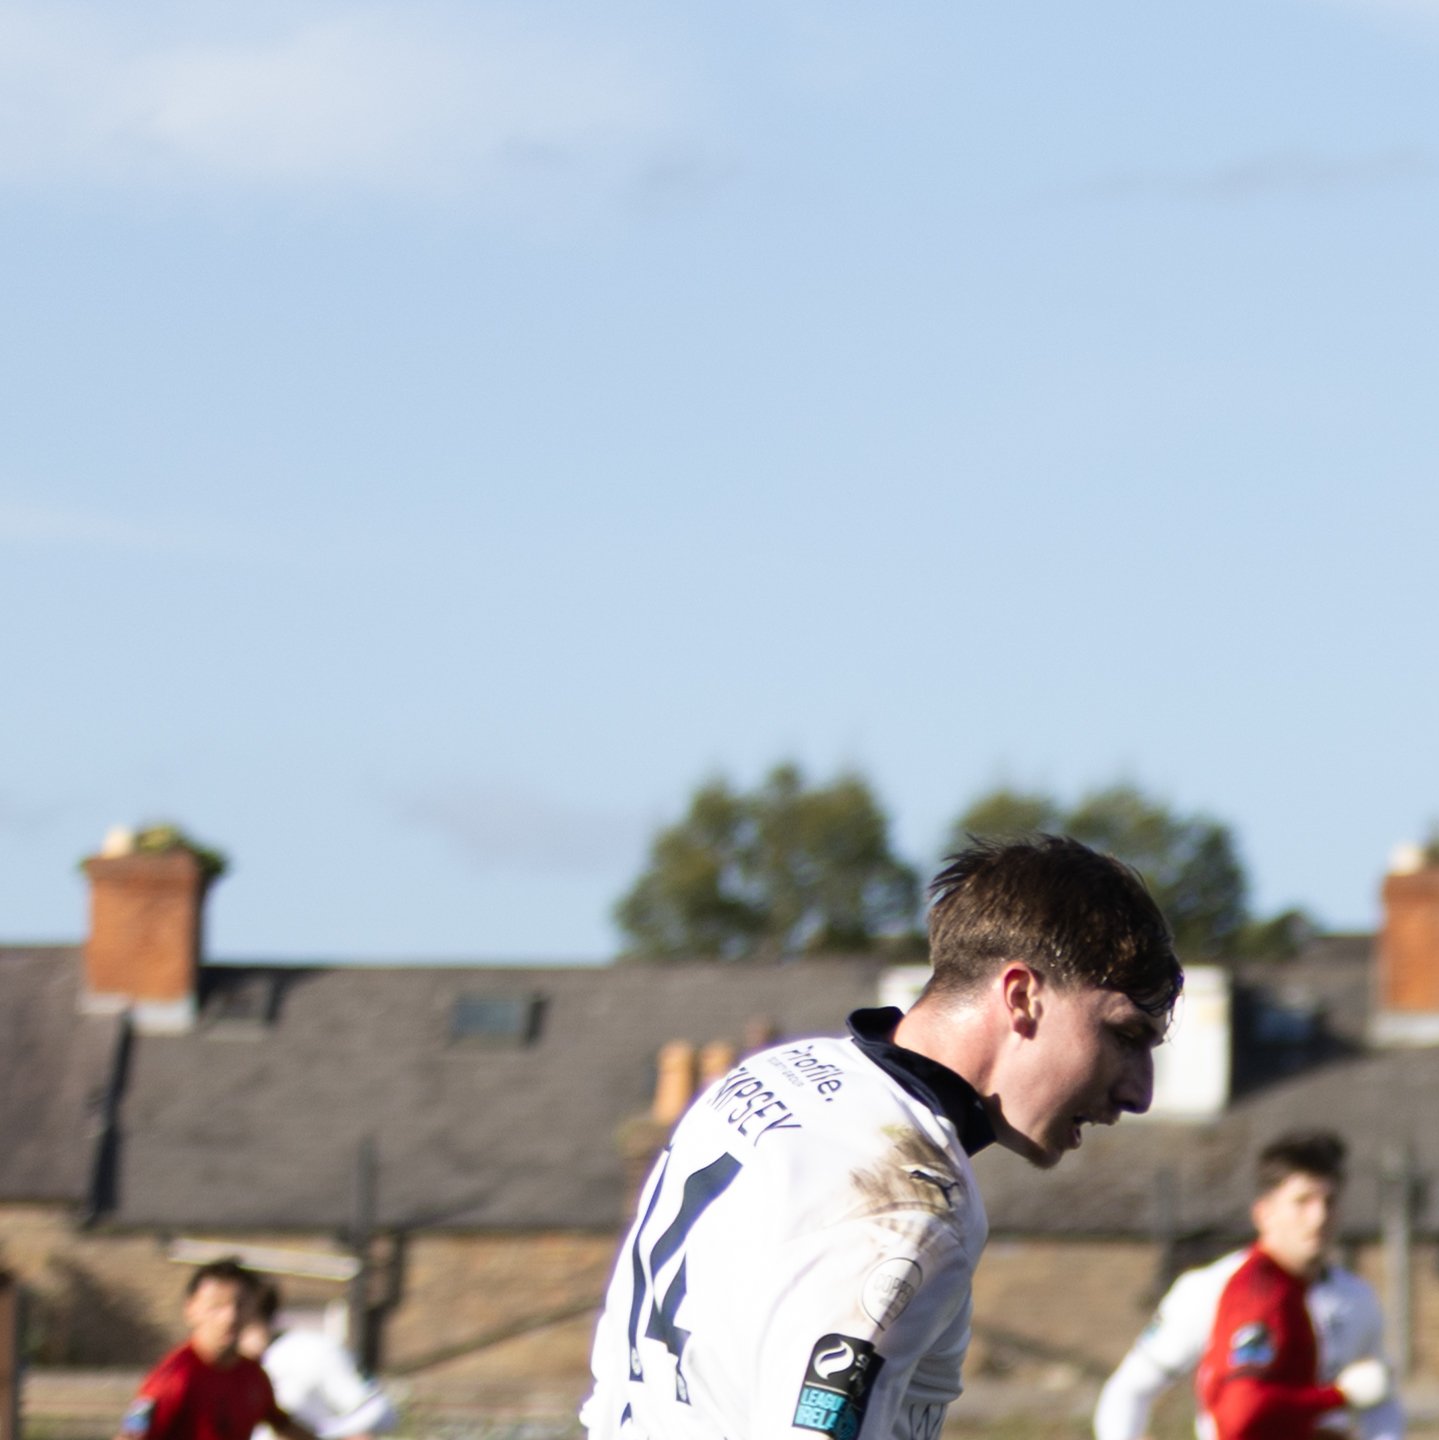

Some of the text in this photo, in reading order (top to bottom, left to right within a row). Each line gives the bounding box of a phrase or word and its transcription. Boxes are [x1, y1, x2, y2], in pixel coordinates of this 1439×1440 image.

[707, 1067, 802, 1147] MPSEY
[627, 1142, 744, 1407] 14
[801, 1388, 846, 1409] LEAGU
